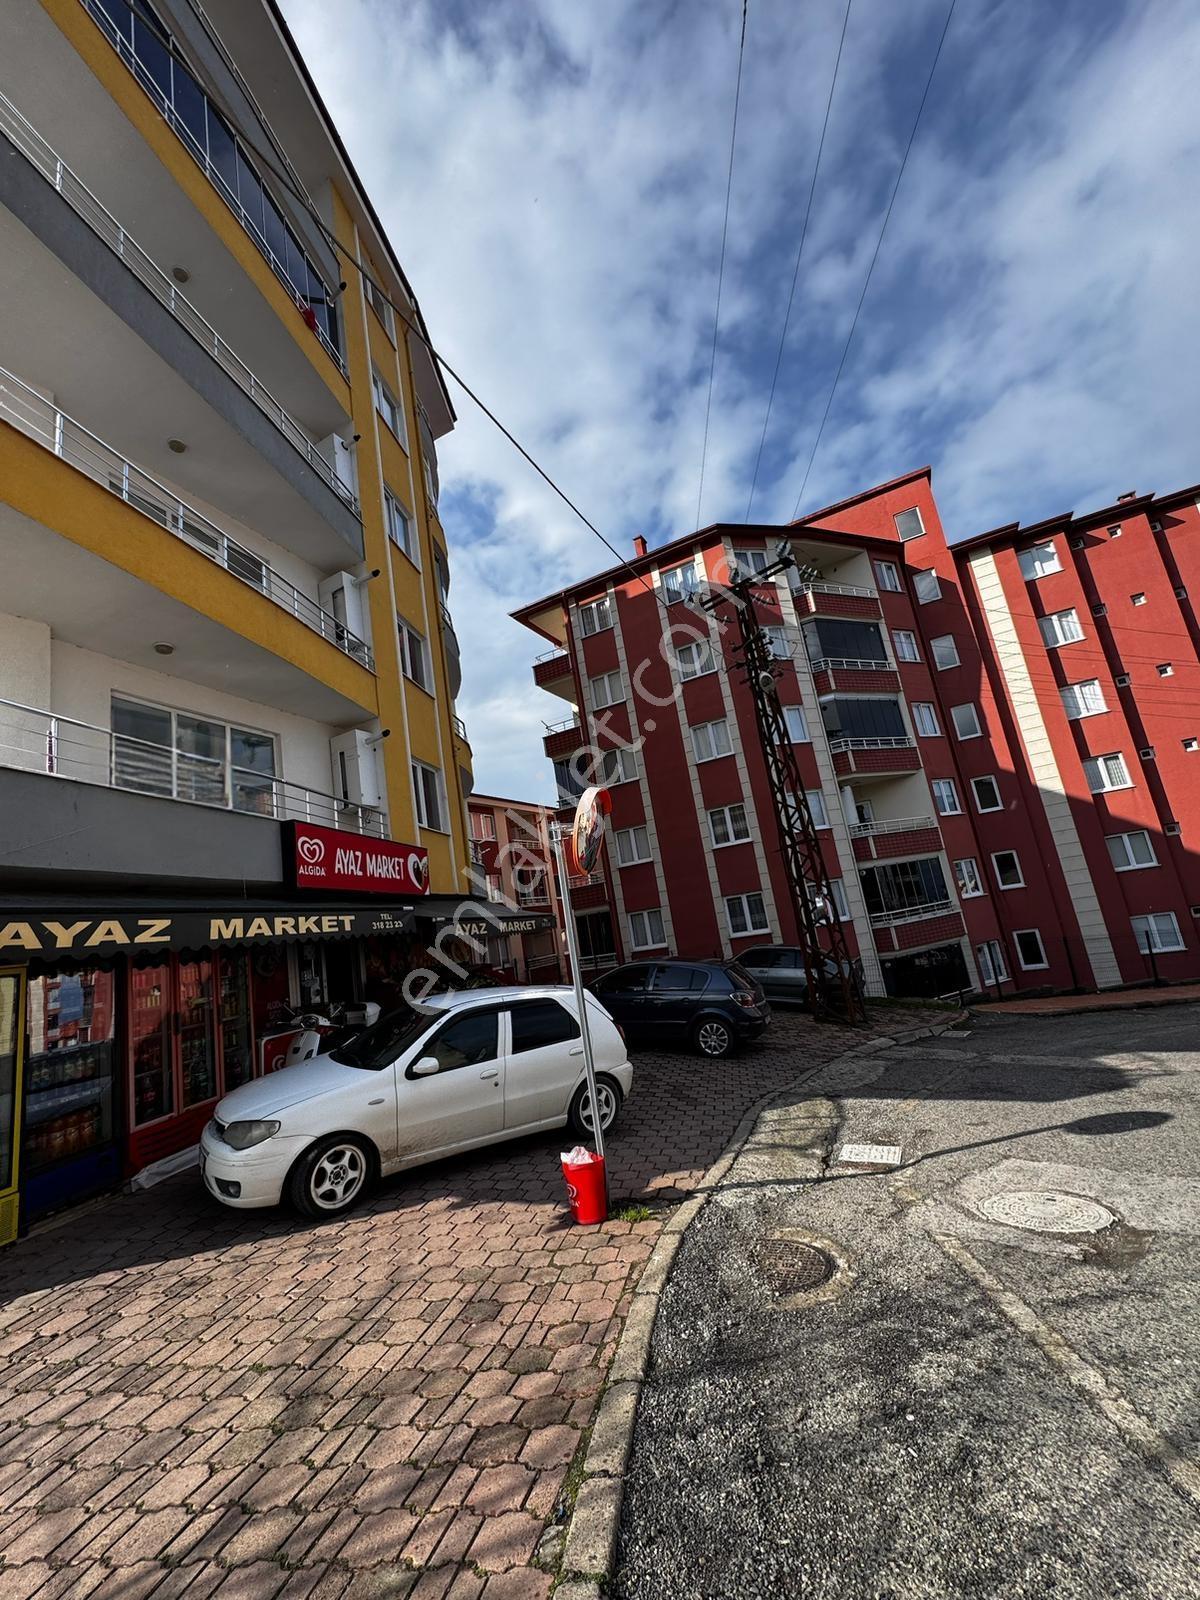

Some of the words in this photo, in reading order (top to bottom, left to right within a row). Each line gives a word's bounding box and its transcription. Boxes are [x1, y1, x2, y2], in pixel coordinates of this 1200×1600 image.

[335, 847, 364, 877] AYAZ
[366, 852, 405, 881] MARKET
[0, 919, 172, 950] AYAZ
[209, 914, 355, 941] MARKET
[455, 922, 488, 936] AYAZ
[499, 920, 536, 933] MARKET
